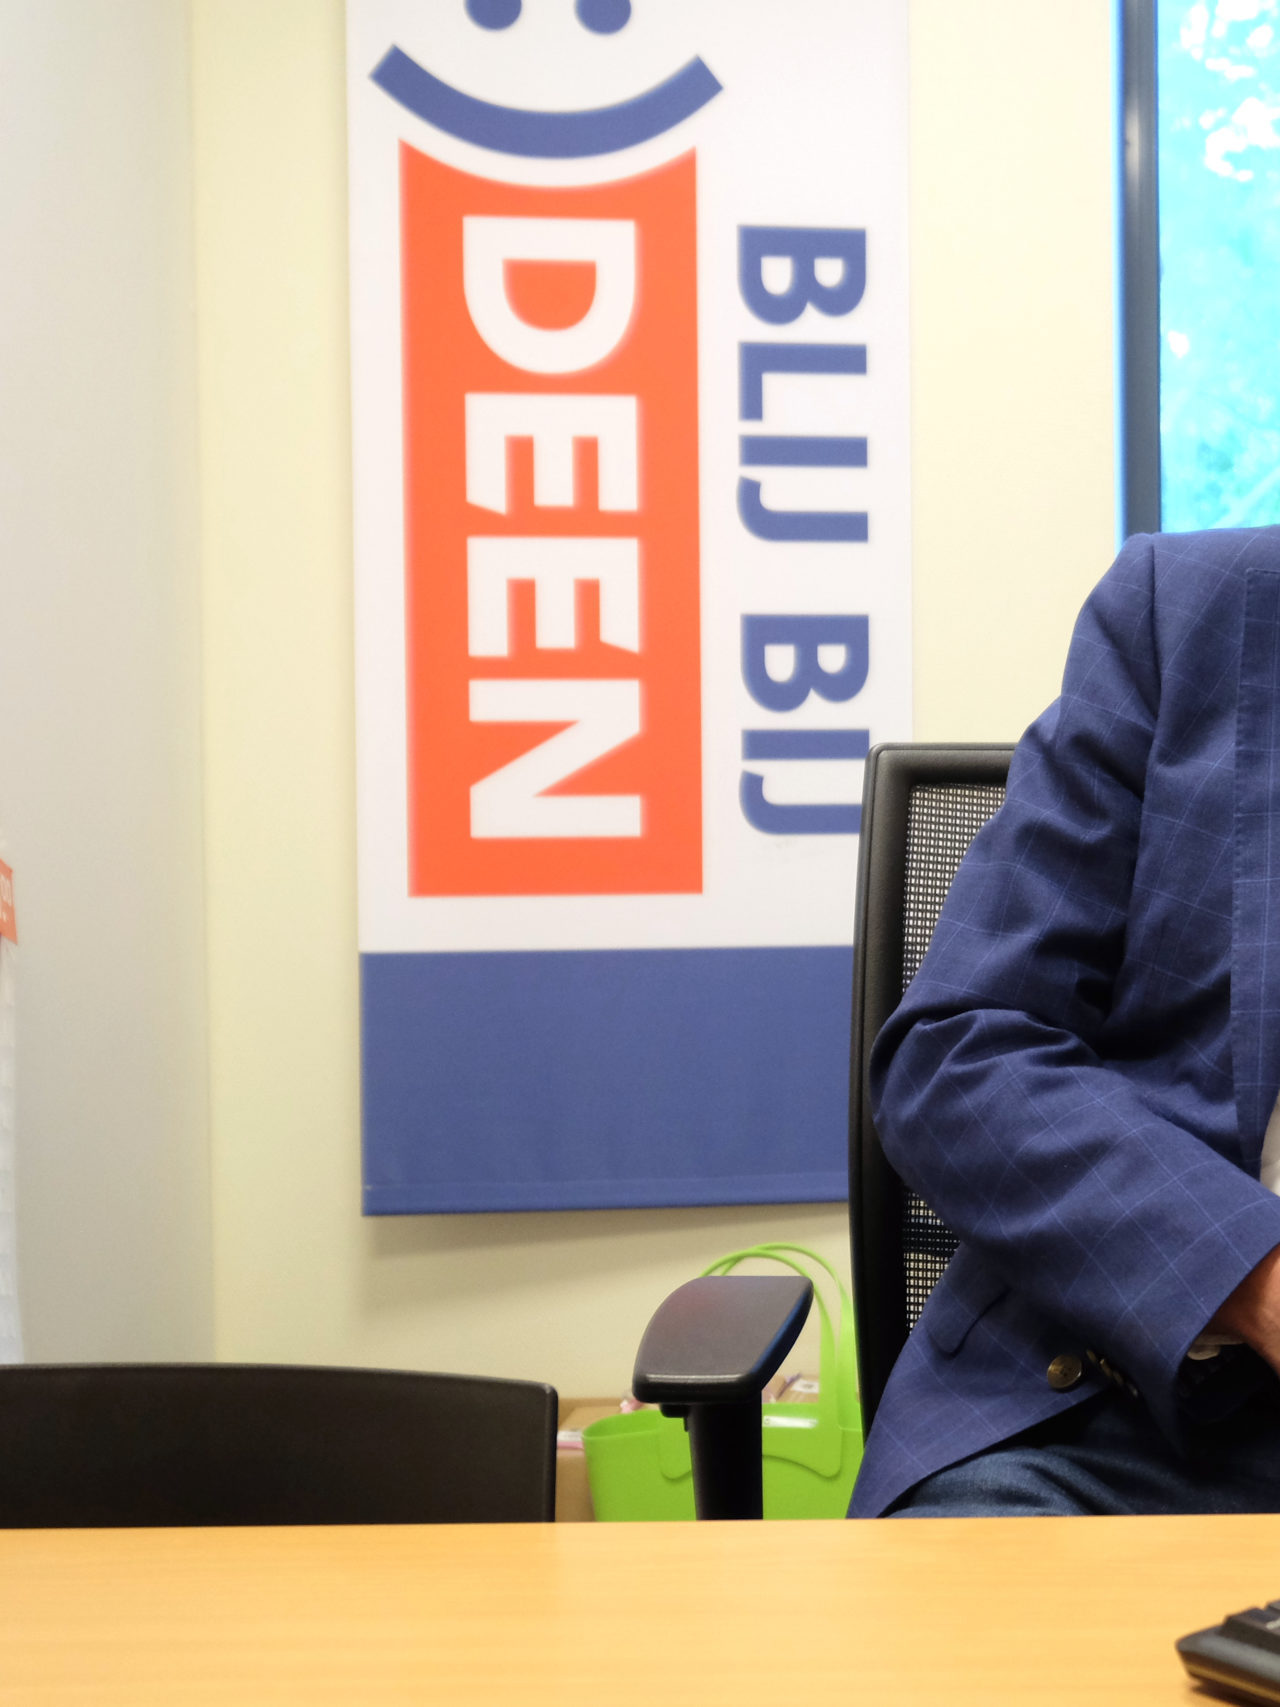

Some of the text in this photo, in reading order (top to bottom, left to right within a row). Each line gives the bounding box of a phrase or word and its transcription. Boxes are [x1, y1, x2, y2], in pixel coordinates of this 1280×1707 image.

[462, 215, 642, 839] DEEN
[737, 224, 870, 835] BLIJ BIJ
